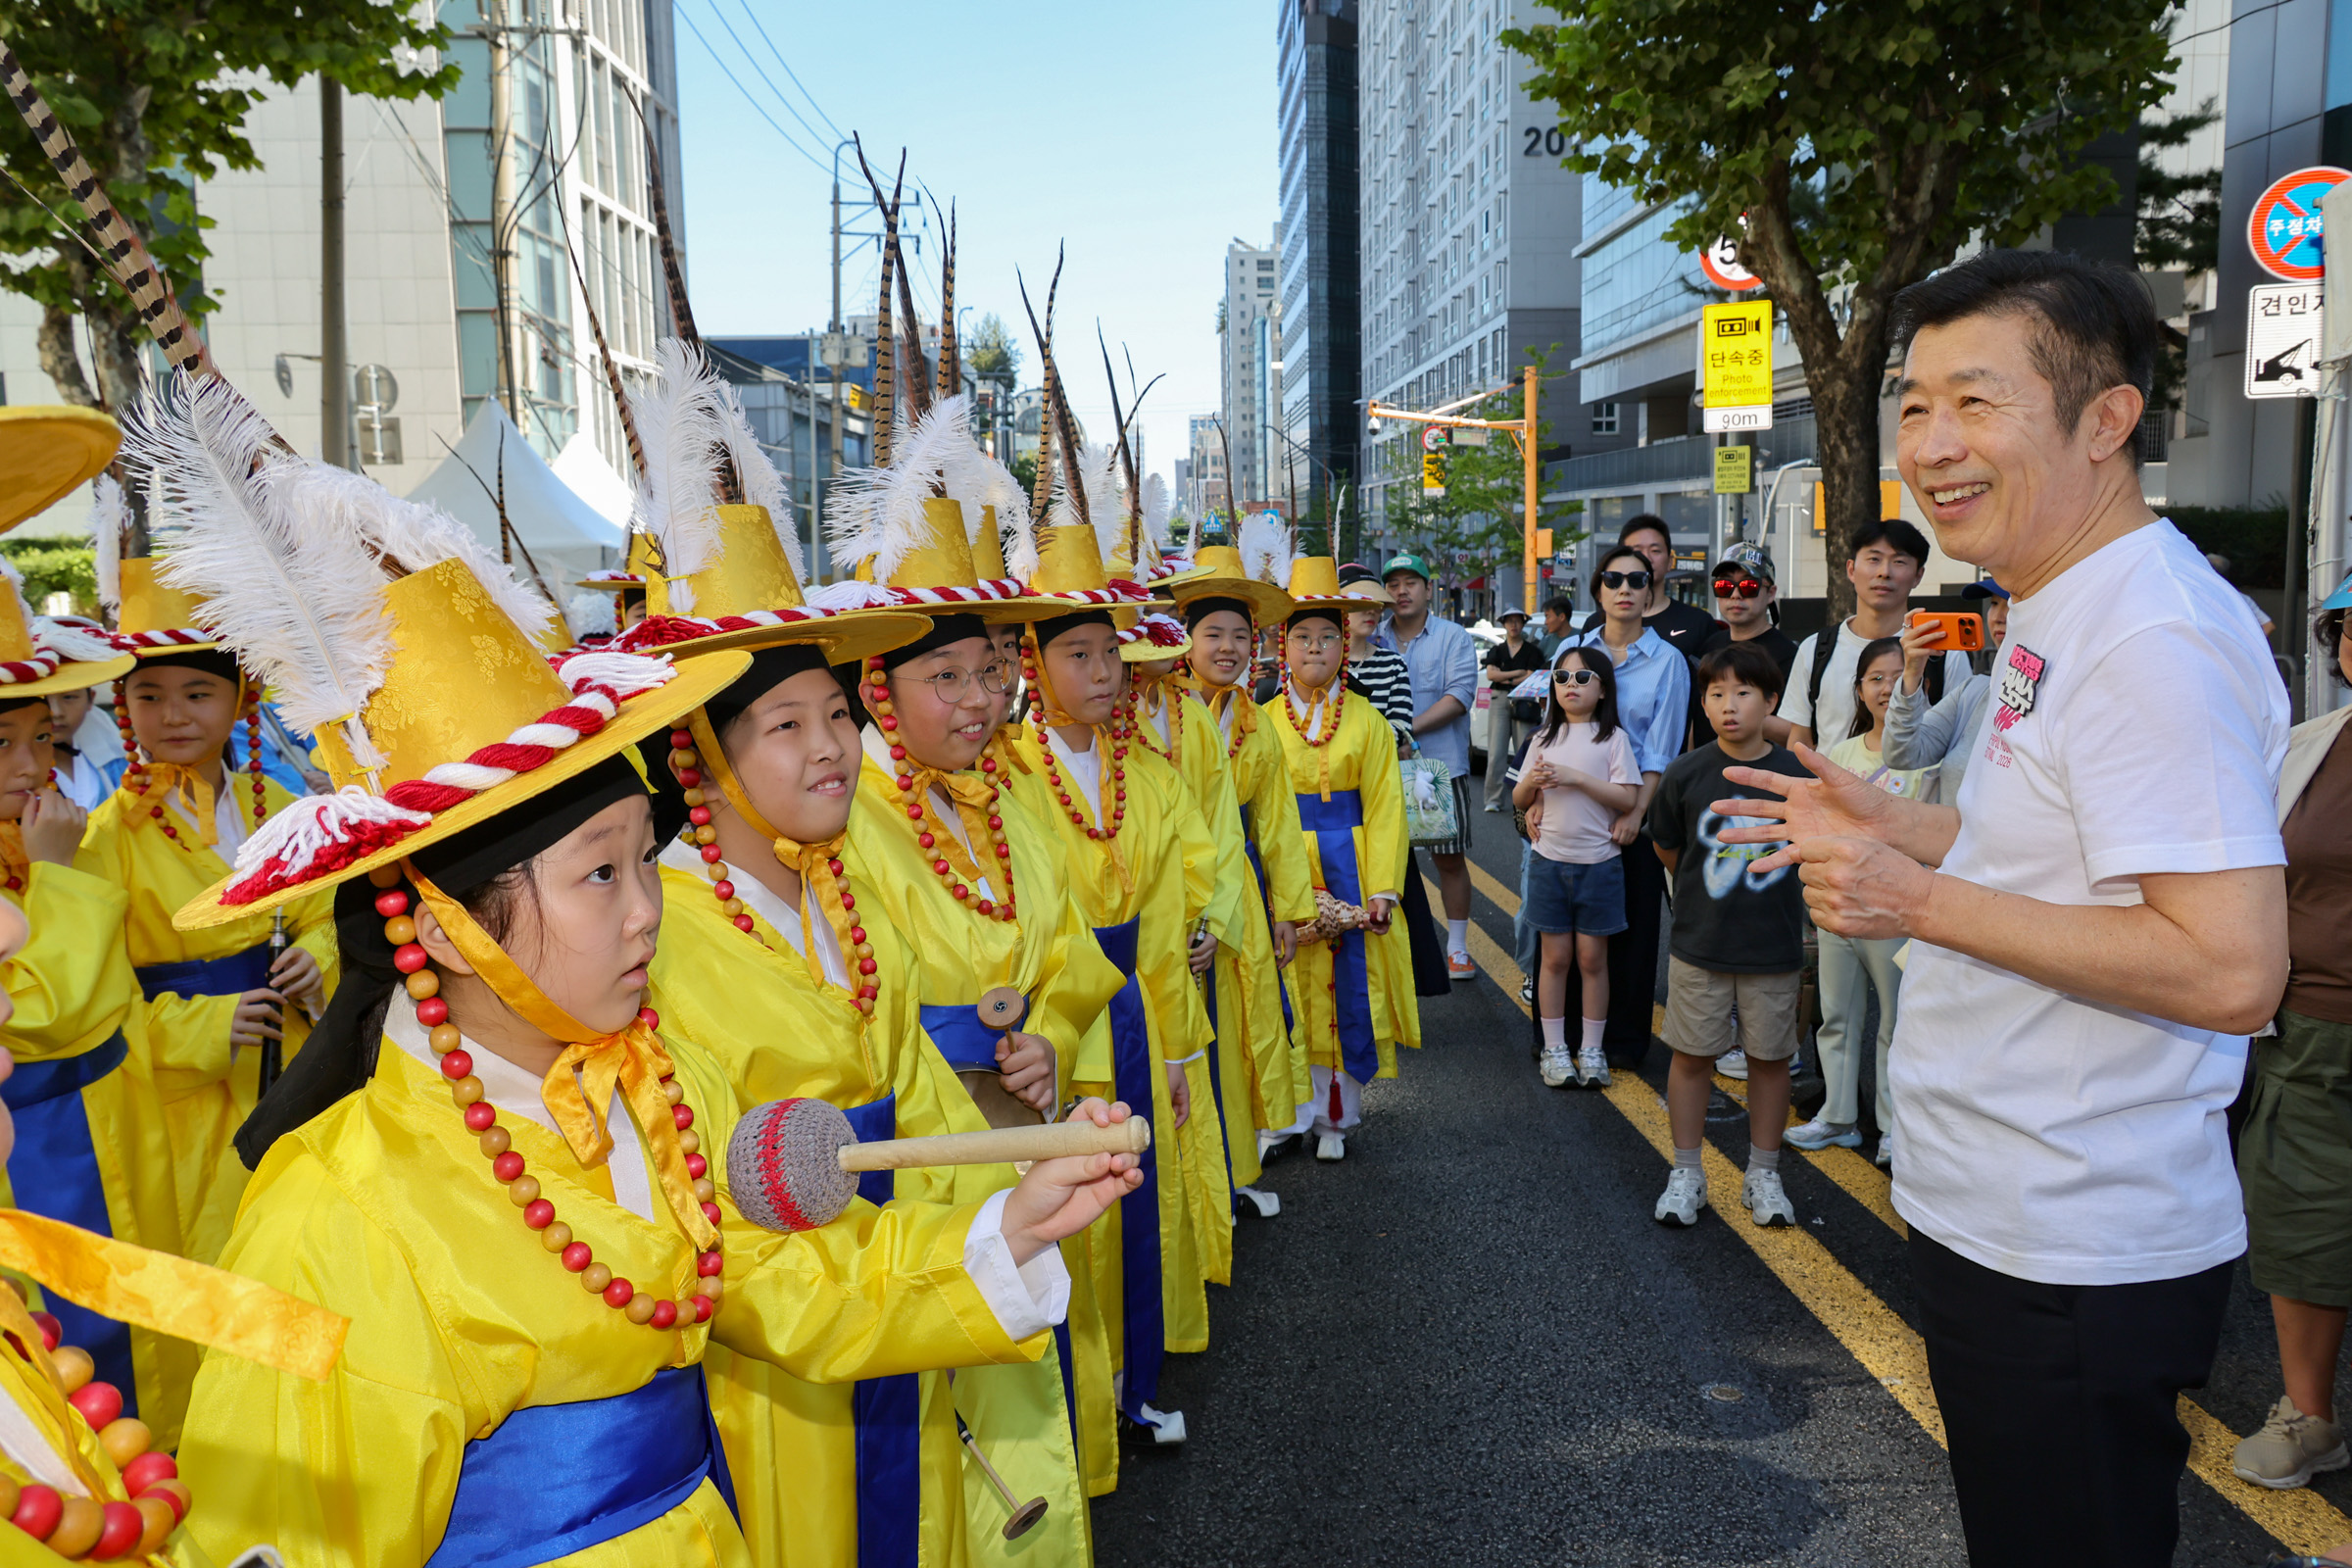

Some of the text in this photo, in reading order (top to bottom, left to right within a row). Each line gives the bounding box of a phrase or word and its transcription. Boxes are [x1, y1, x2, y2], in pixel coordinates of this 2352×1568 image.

[1524, 126, 1580, 156] 20
[1711, 349, 1764, 368] 단속중
[1722, 374, 1753, 384] Photo
[1709, 386, 1767, 398] enforcement
[1722, 414, 1758, 429] 90m
